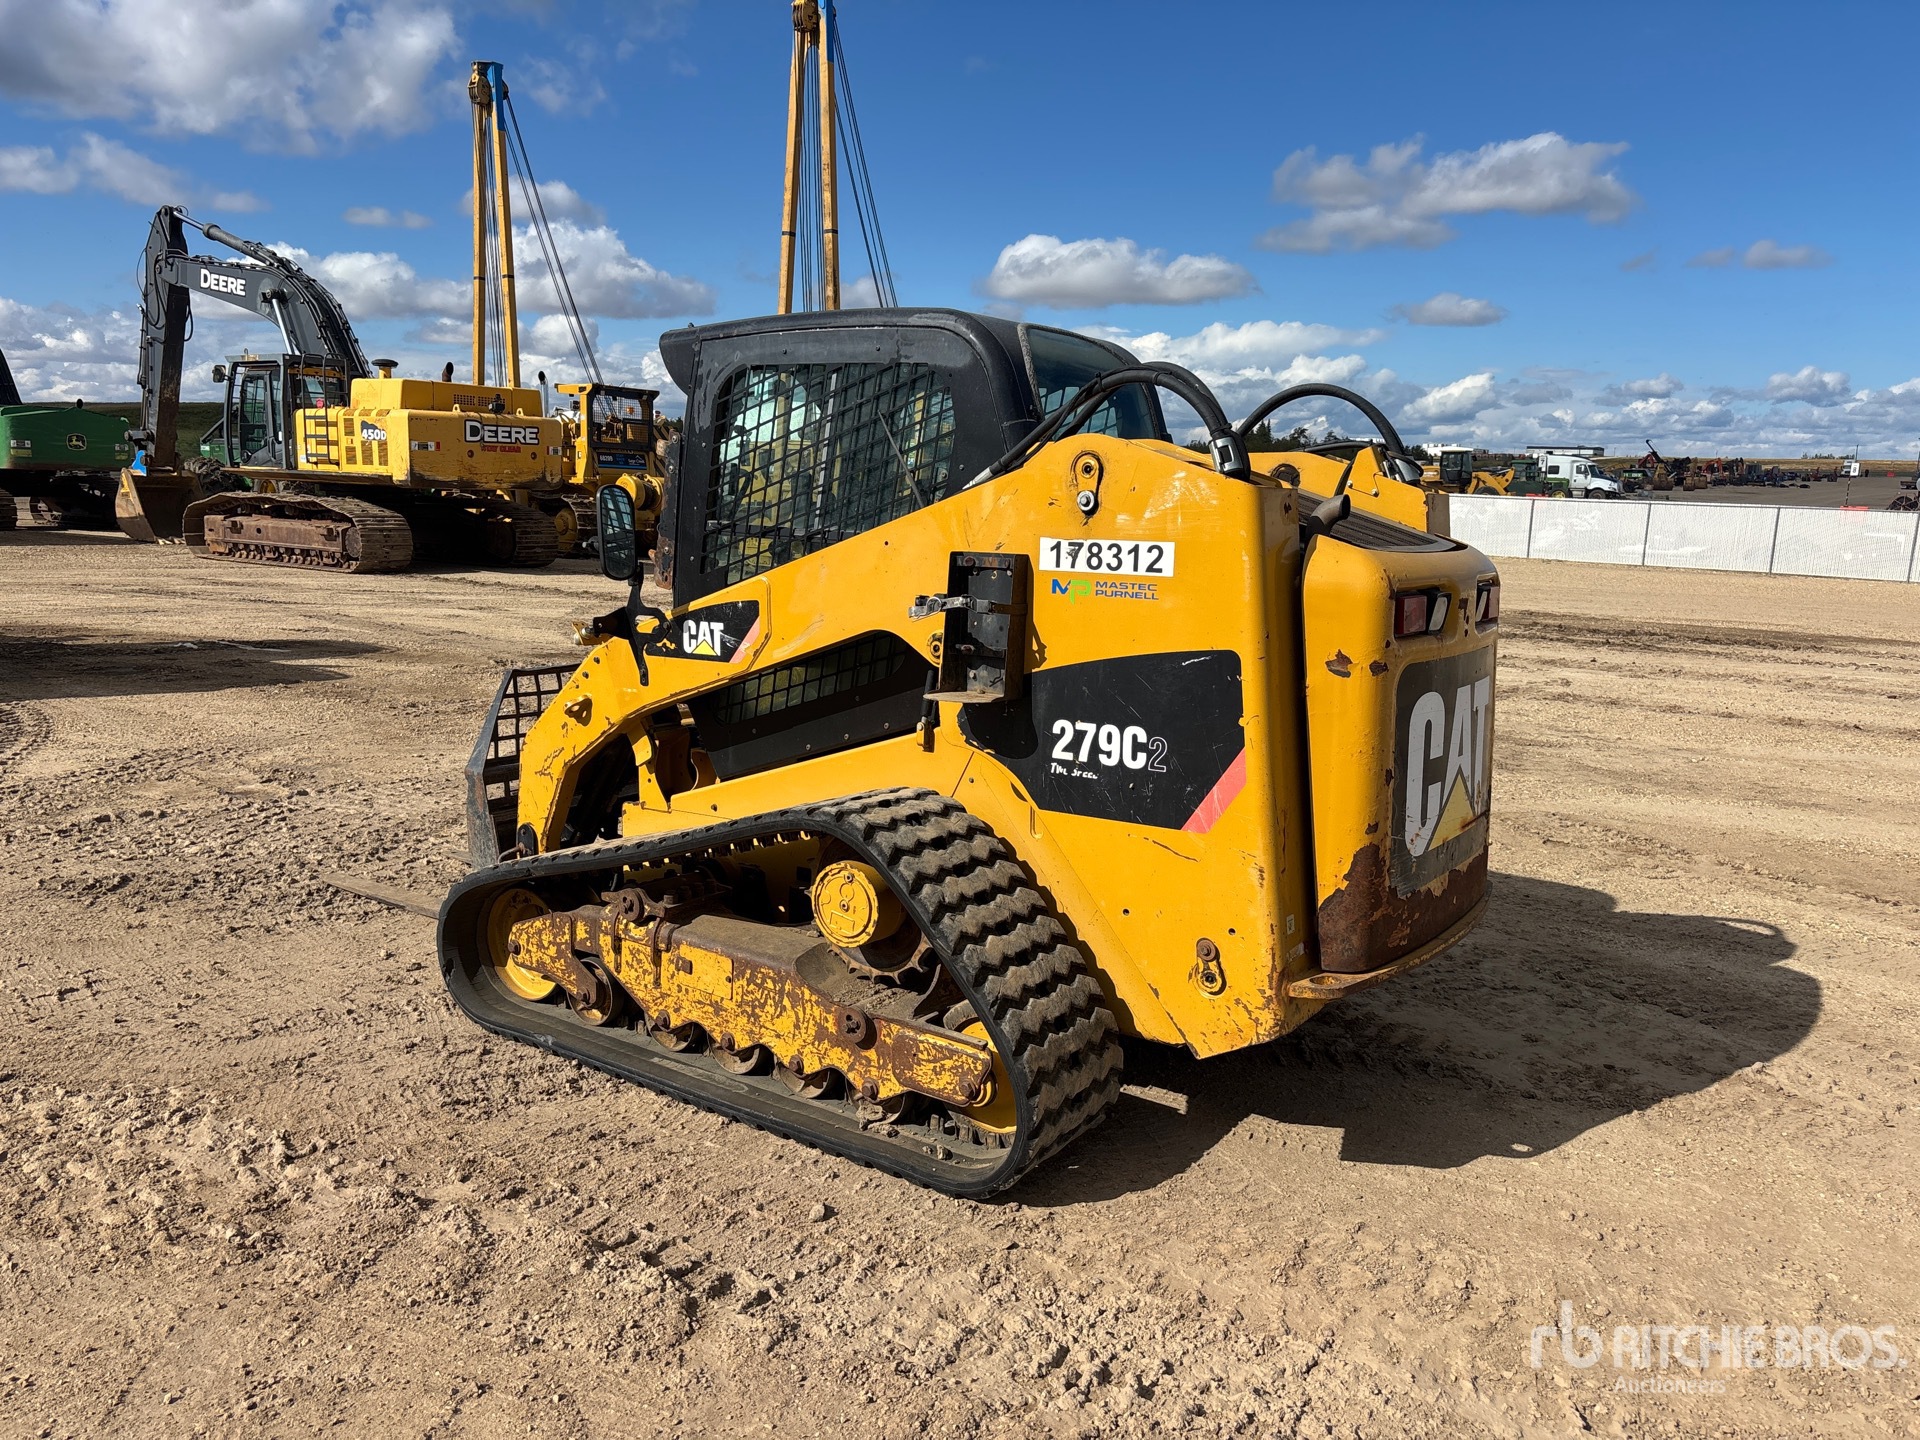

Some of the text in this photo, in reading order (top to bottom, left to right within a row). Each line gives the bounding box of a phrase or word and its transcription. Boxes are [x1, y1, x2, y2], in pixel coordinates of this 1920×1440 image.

[200, 268, 246, 296] DEERE
[361, 429, 387, 440] 450D
[465, 420, 539, 444] DEERE
[1050, 541, 1164, 573] 178312
[1095, 581, 1158, 591] MASTEC
[1095, 590, 1159, 600] PURNELL
[682, 619, 724, 656] CAT
[1404, 676, 1490, 857] CAT
